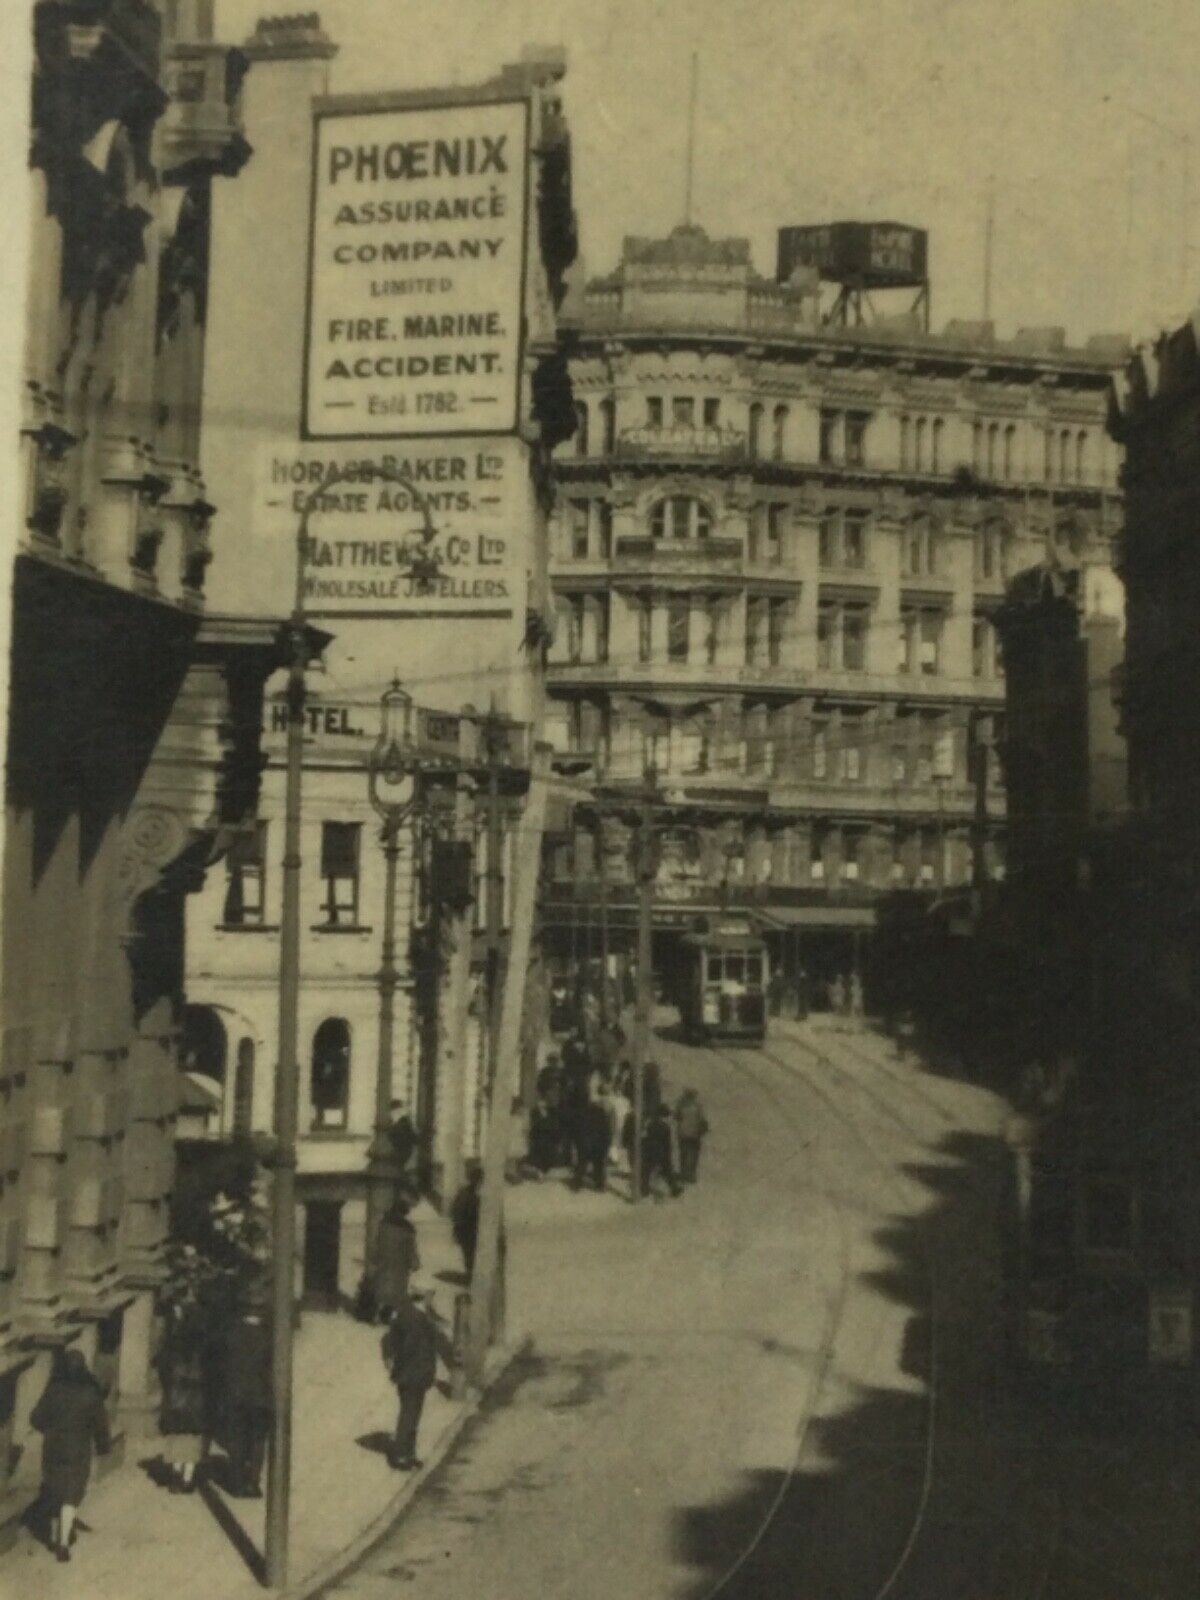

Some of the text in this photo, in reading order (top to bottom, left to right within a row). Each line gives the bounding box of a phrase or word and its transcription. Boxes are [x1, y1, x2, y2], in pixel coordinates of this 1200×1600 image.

[334, 194, 505, 225] ASSURANCE
[332, 238, 504, 265] COMPANY
[369, 277, 452, 298] LIMITED
[382, 455, 466, 480] BAKER
[272, 704, 364, 735] HTEL.
